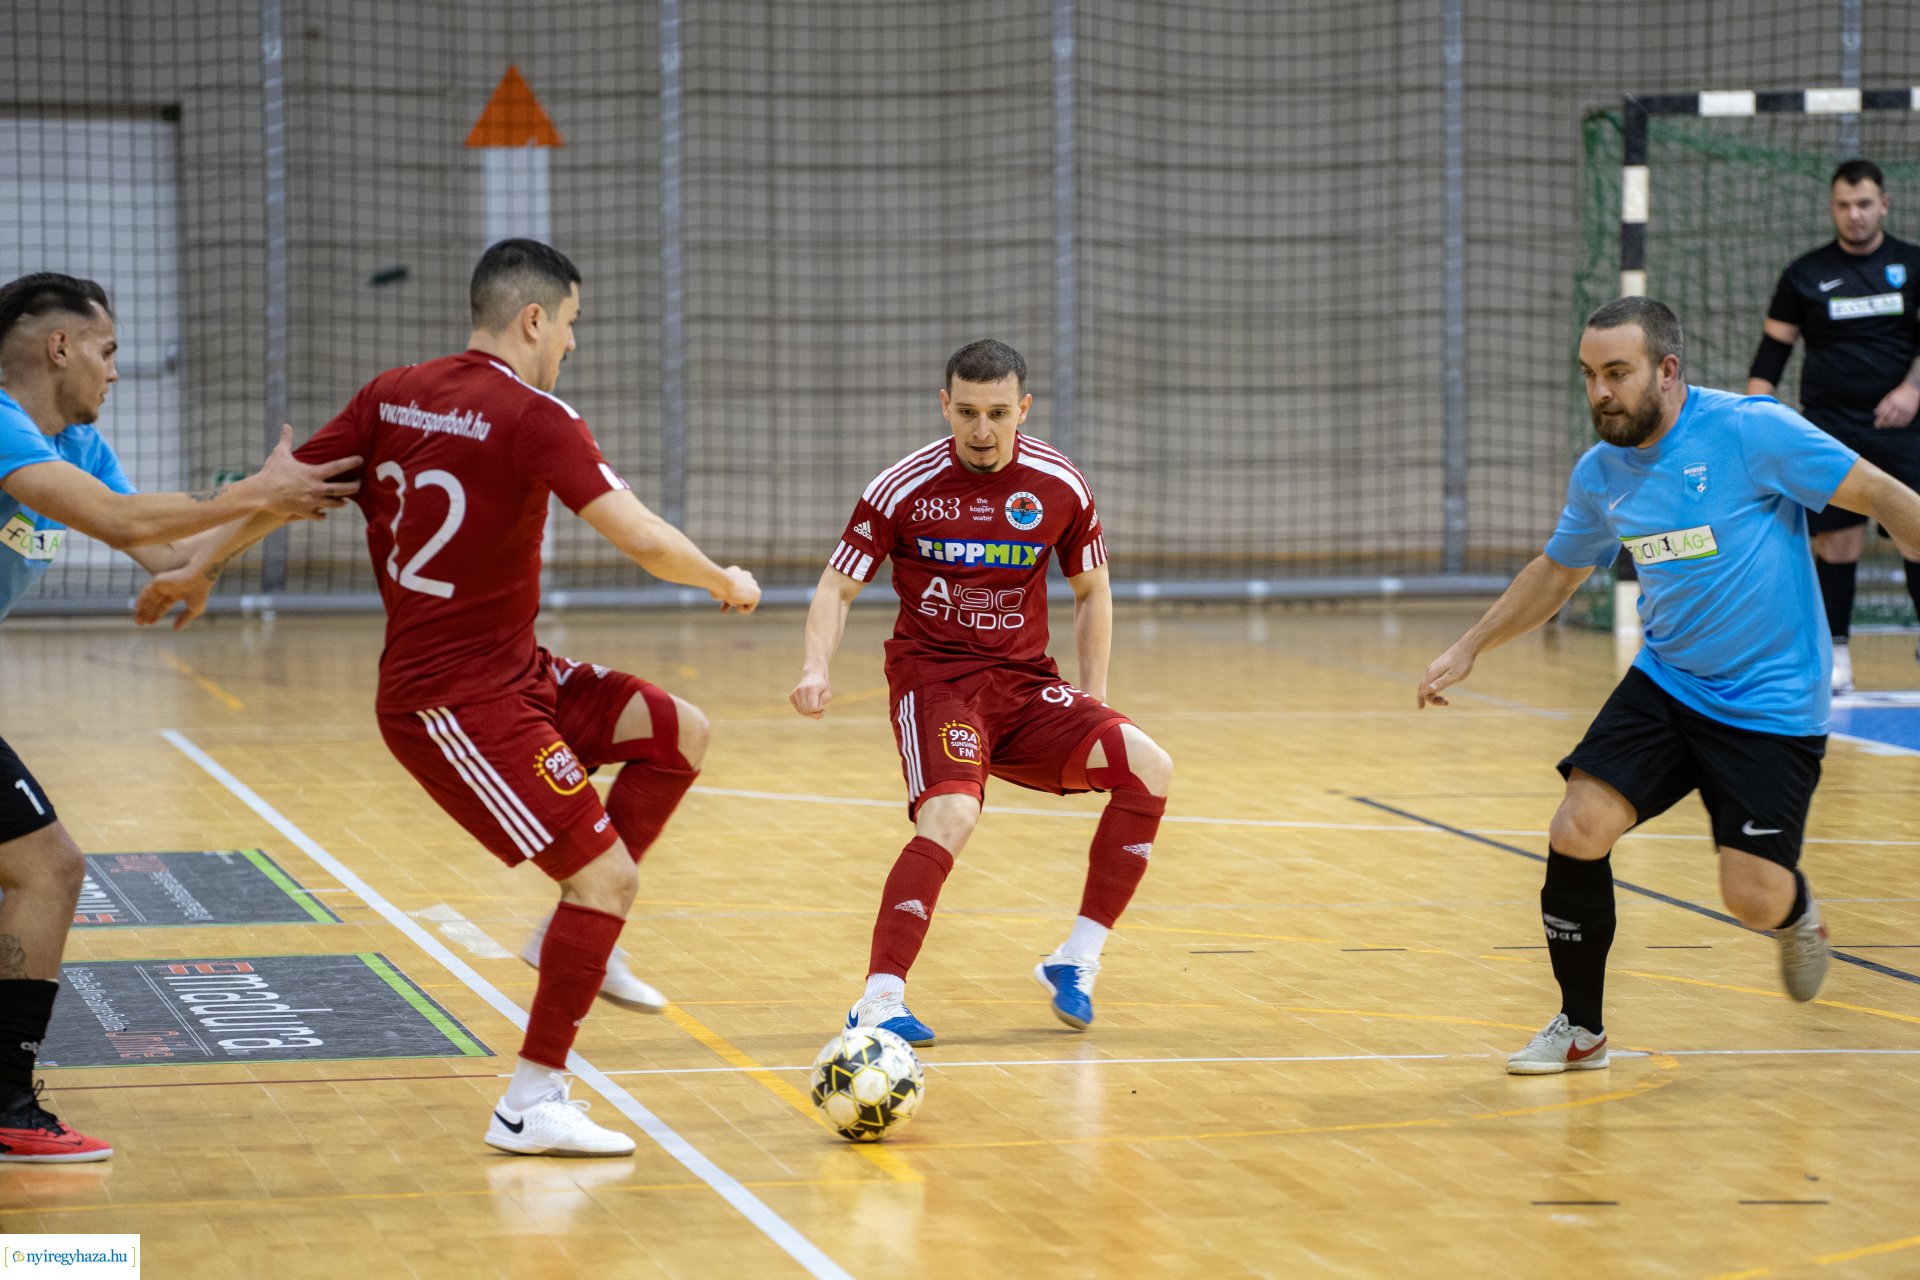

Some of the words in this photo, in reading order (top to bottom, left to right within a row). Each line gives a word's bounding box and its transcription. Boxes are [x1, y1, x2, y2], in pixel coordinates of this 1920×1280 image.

[911, 497, 961, 522] 383
[375, 460, 467, 600] 22
[917, 601, 1025, 631] STUDIO
[949, 729, 978, 745] 99.4
[959, 747, 975, 759] FM
[566, 769, 583, 786] FM
